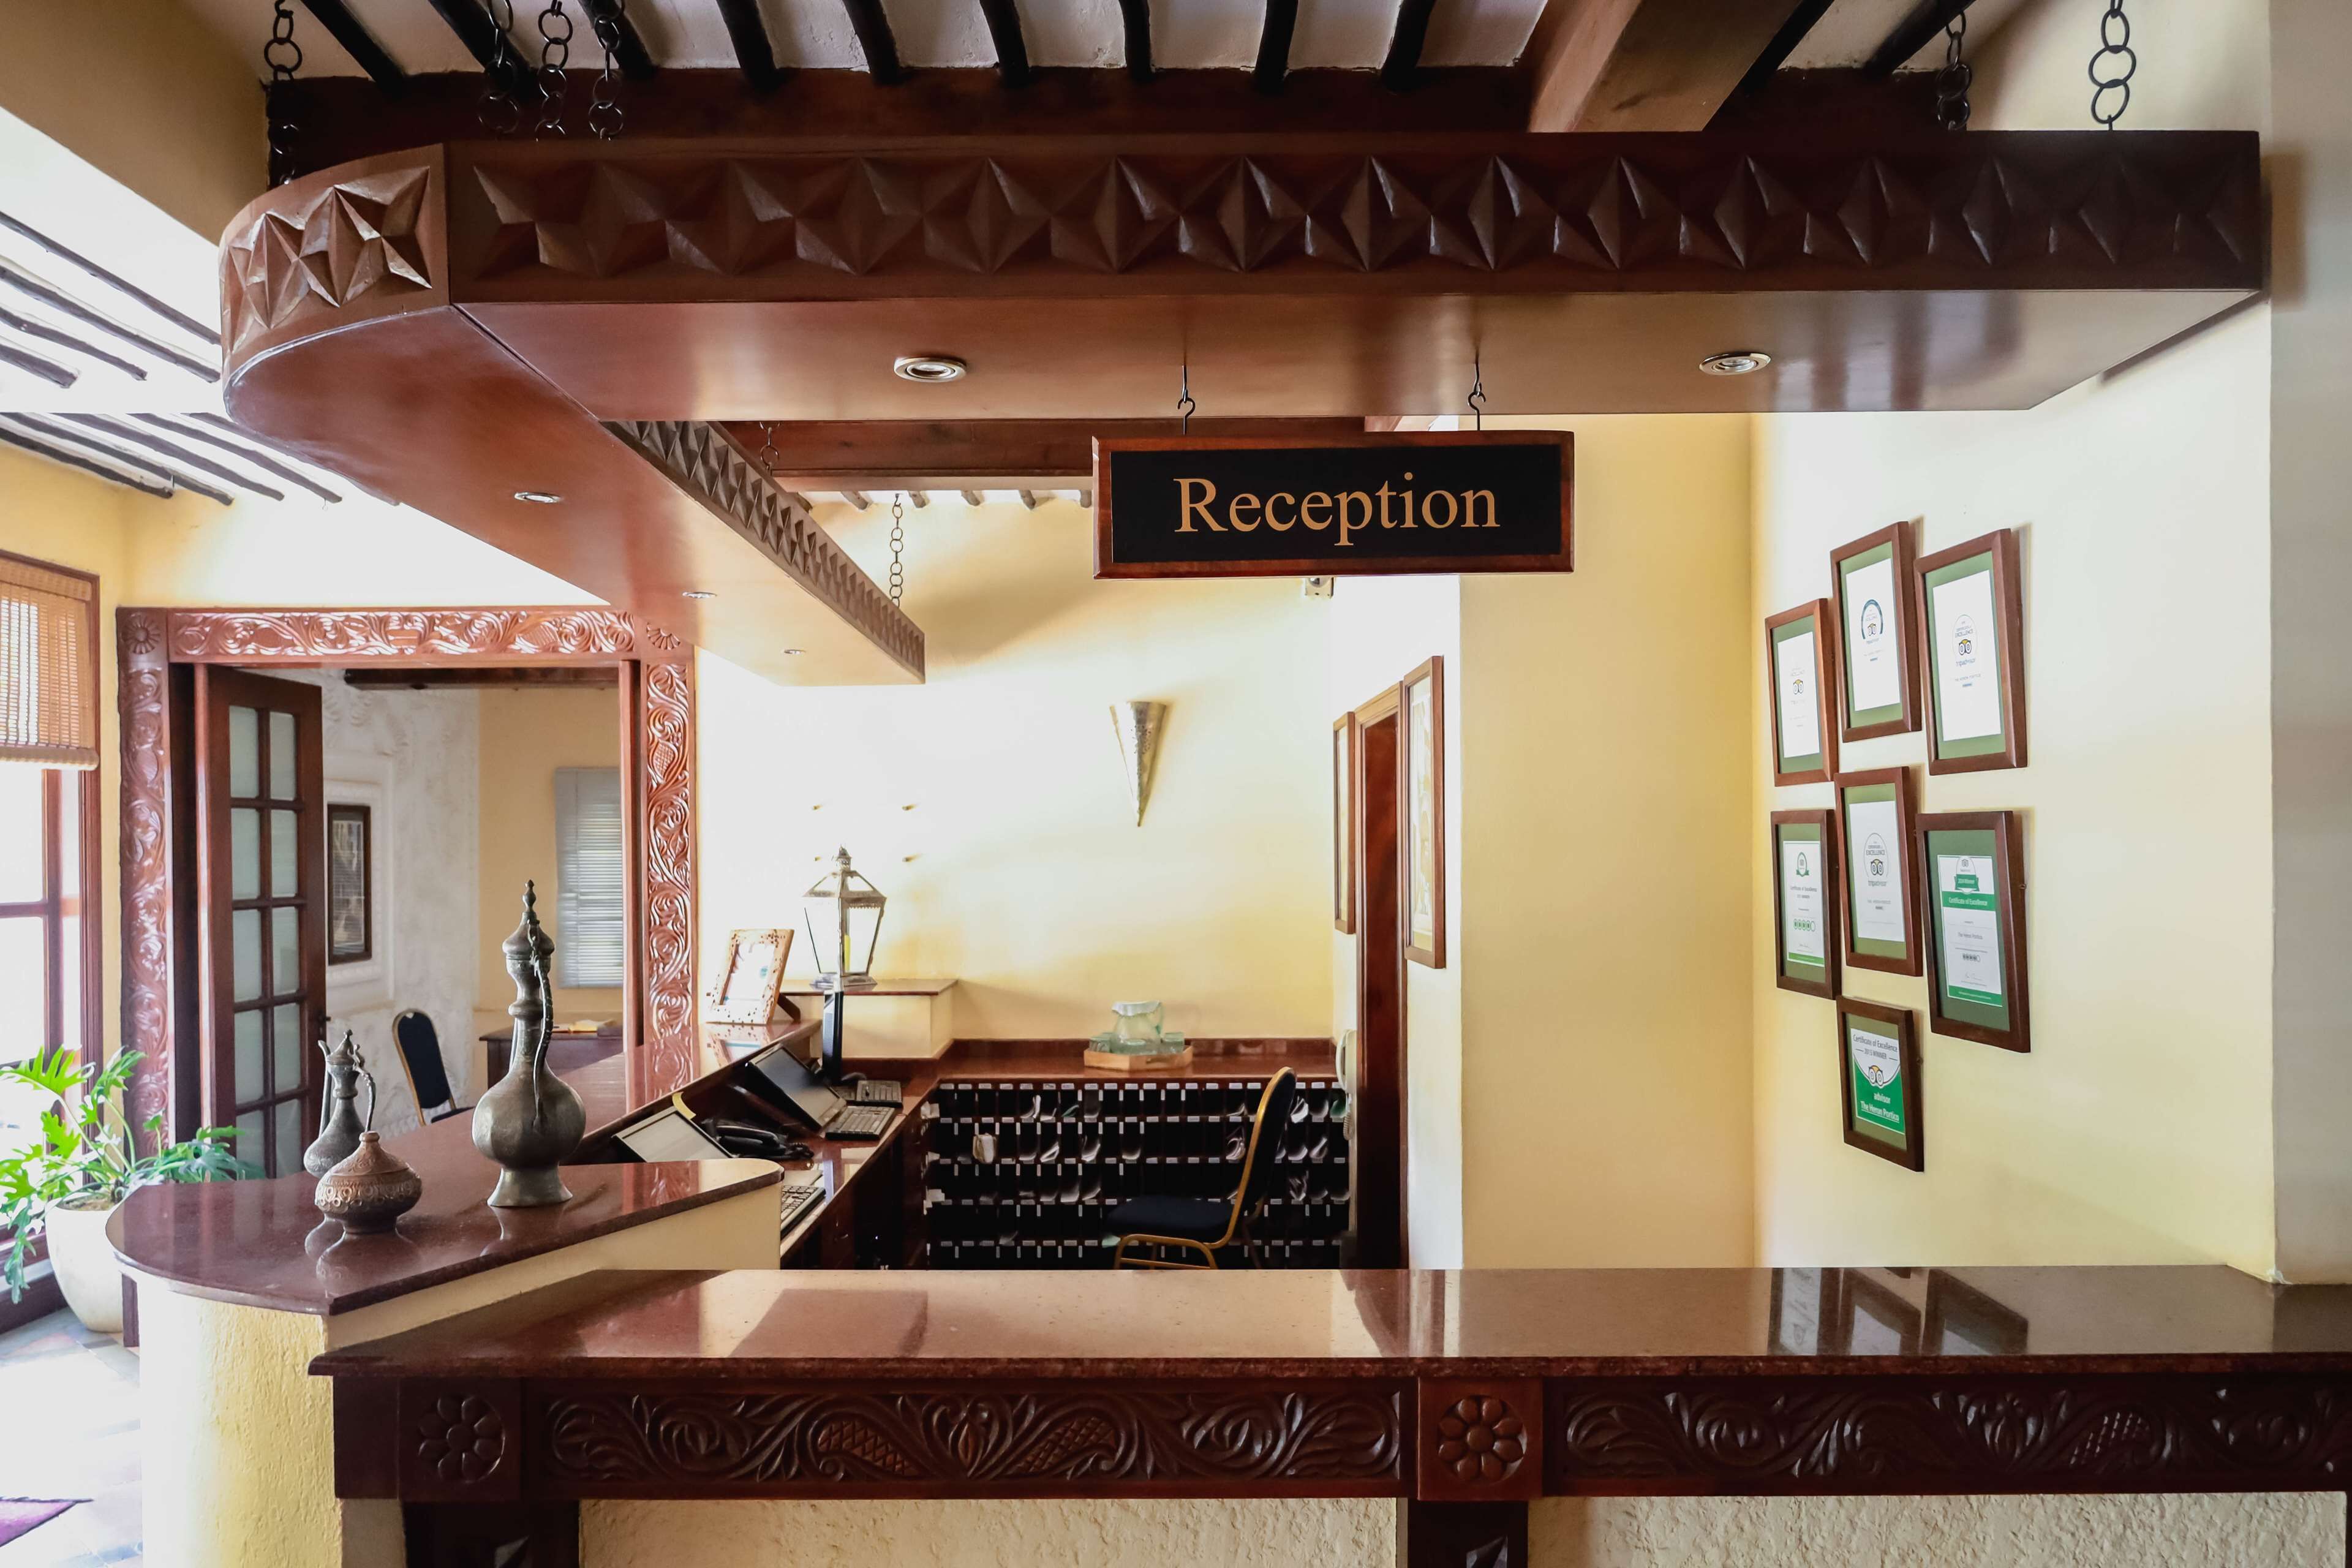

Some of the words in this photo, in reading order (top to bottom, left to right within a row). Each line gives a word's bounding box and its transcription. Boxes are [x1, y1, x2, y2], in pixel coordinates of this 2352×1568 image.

[1172, 472, 1501, 546] Reception
[1853, 1034, 1872, 1046] Certificate
[1877, 1040, 1898, 1052] Excellence
[1872, 1050, 1887, 1060] WINNER
[1874, 1091, 1891, 1104] advisor
[1860, 1101, 1869, 1110] The
[1883, 1108, 1899, 1122] Portico
